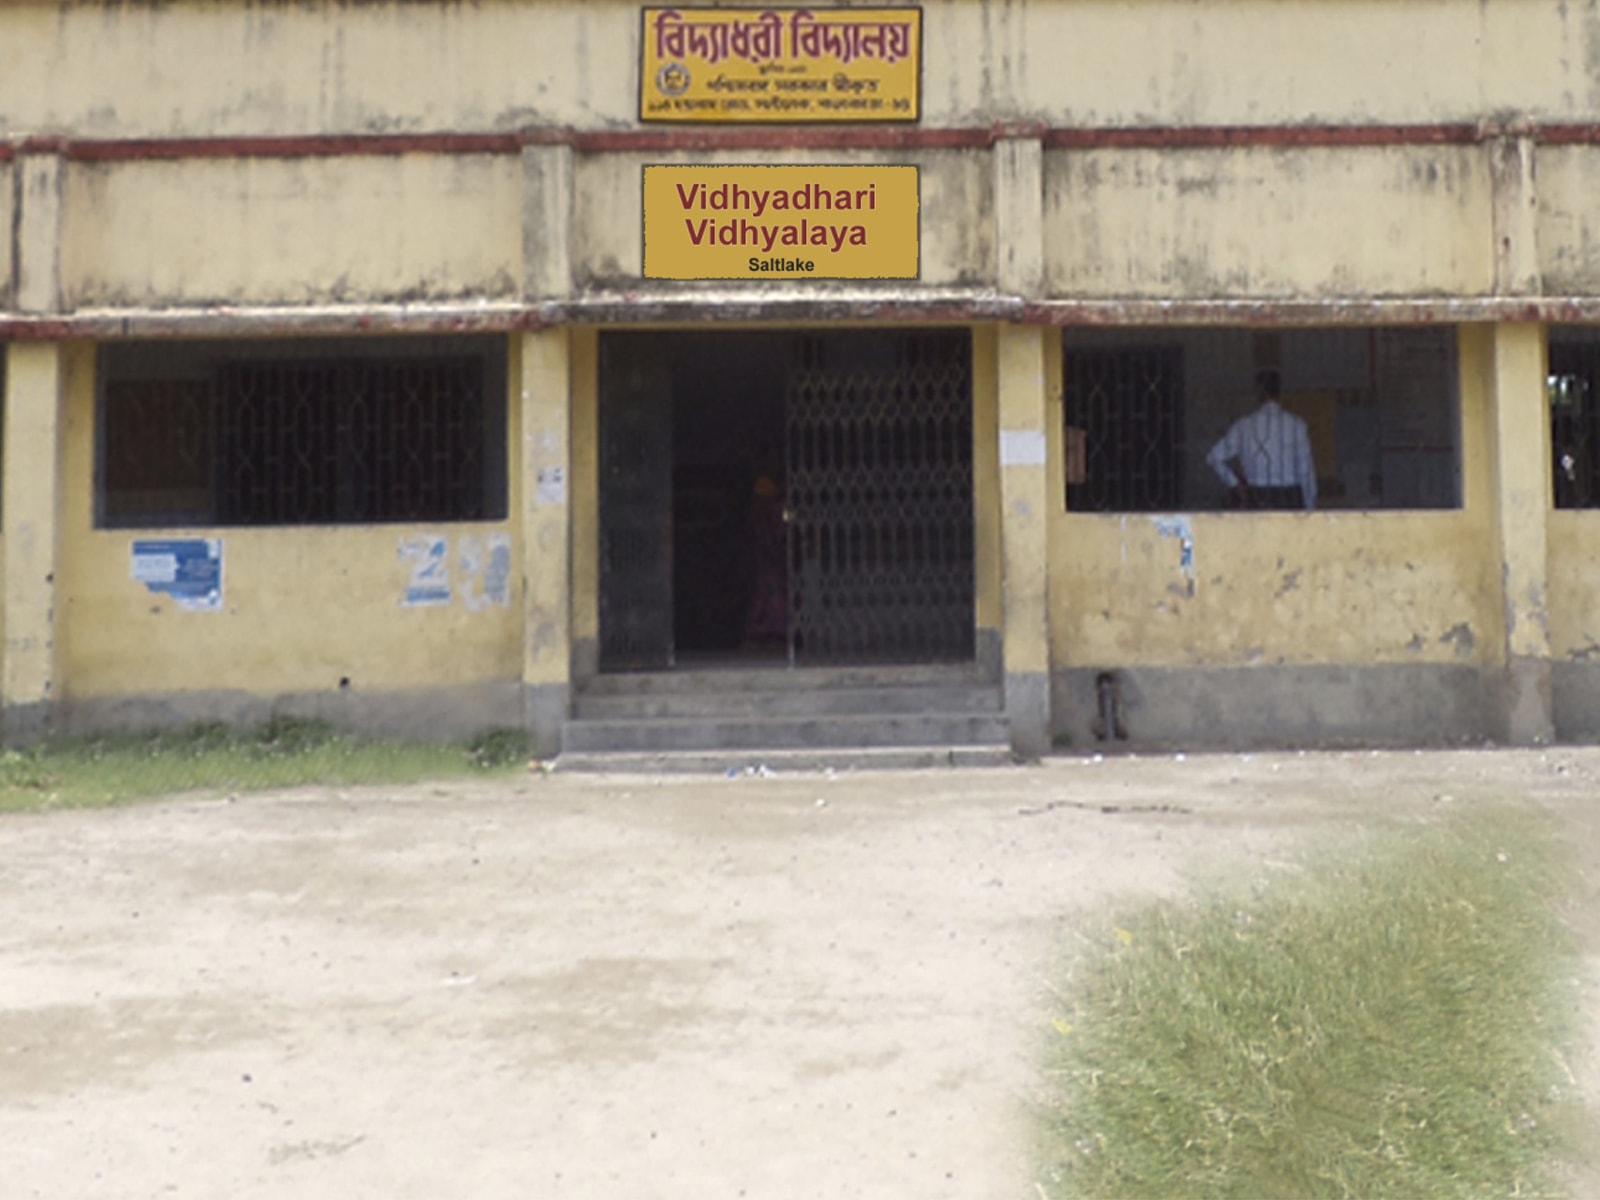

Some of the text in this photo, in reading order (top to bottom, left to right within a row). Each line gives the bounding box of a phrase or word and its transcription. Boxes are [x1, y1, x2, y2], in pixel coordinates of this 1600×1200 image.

[654, 8, 911, 64] বিদ্যাধরী বিদ্যালয়
[676, 183, 876, 217] Vidhyadhari
[685, 218, 867, 253] Vidhyalaya
[748, 257, 815, 272] Saltlake
